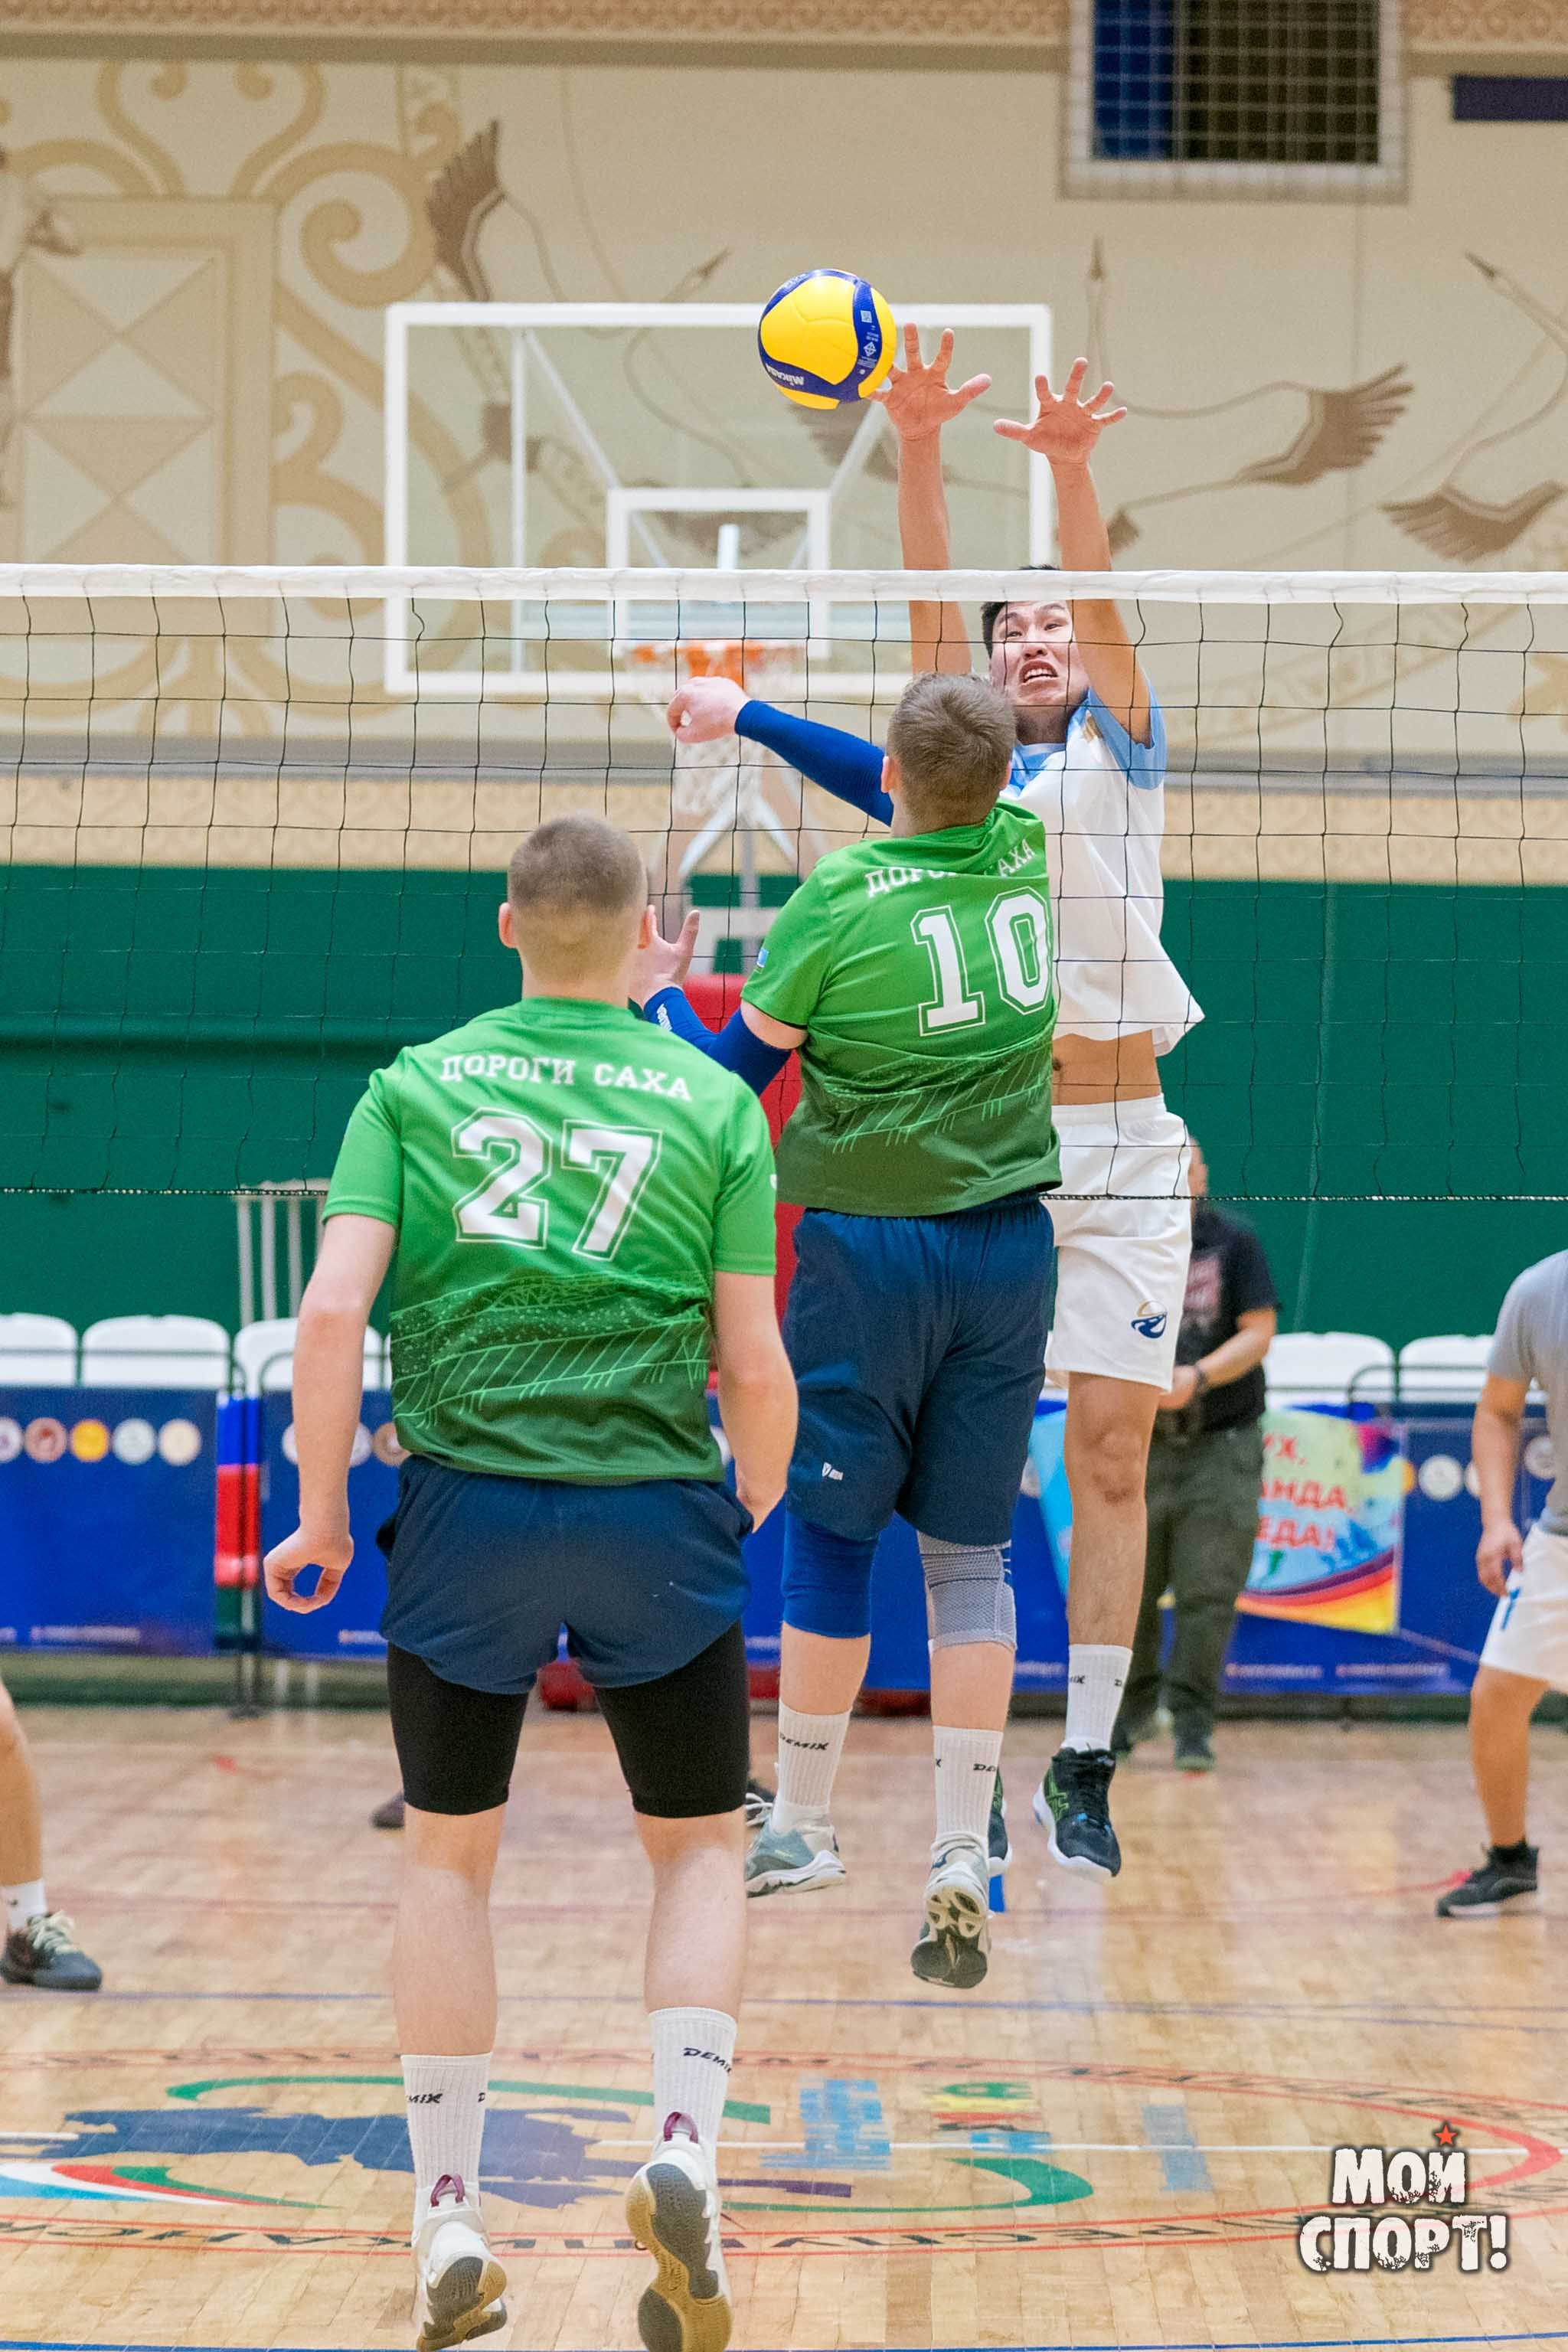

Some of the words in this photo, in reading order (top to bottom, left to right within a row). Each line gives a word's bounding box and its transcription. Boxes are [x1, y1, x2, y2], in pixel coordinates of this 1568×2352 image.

[985, 839, 1035, 878] АХА
[910, 887, 1052, 1037] 10
[439, 1054, 577, 1086] ДОРОГИ
[594, 1063, 693, 1102] САХА
[451, 1106, 663, 1262] 27
